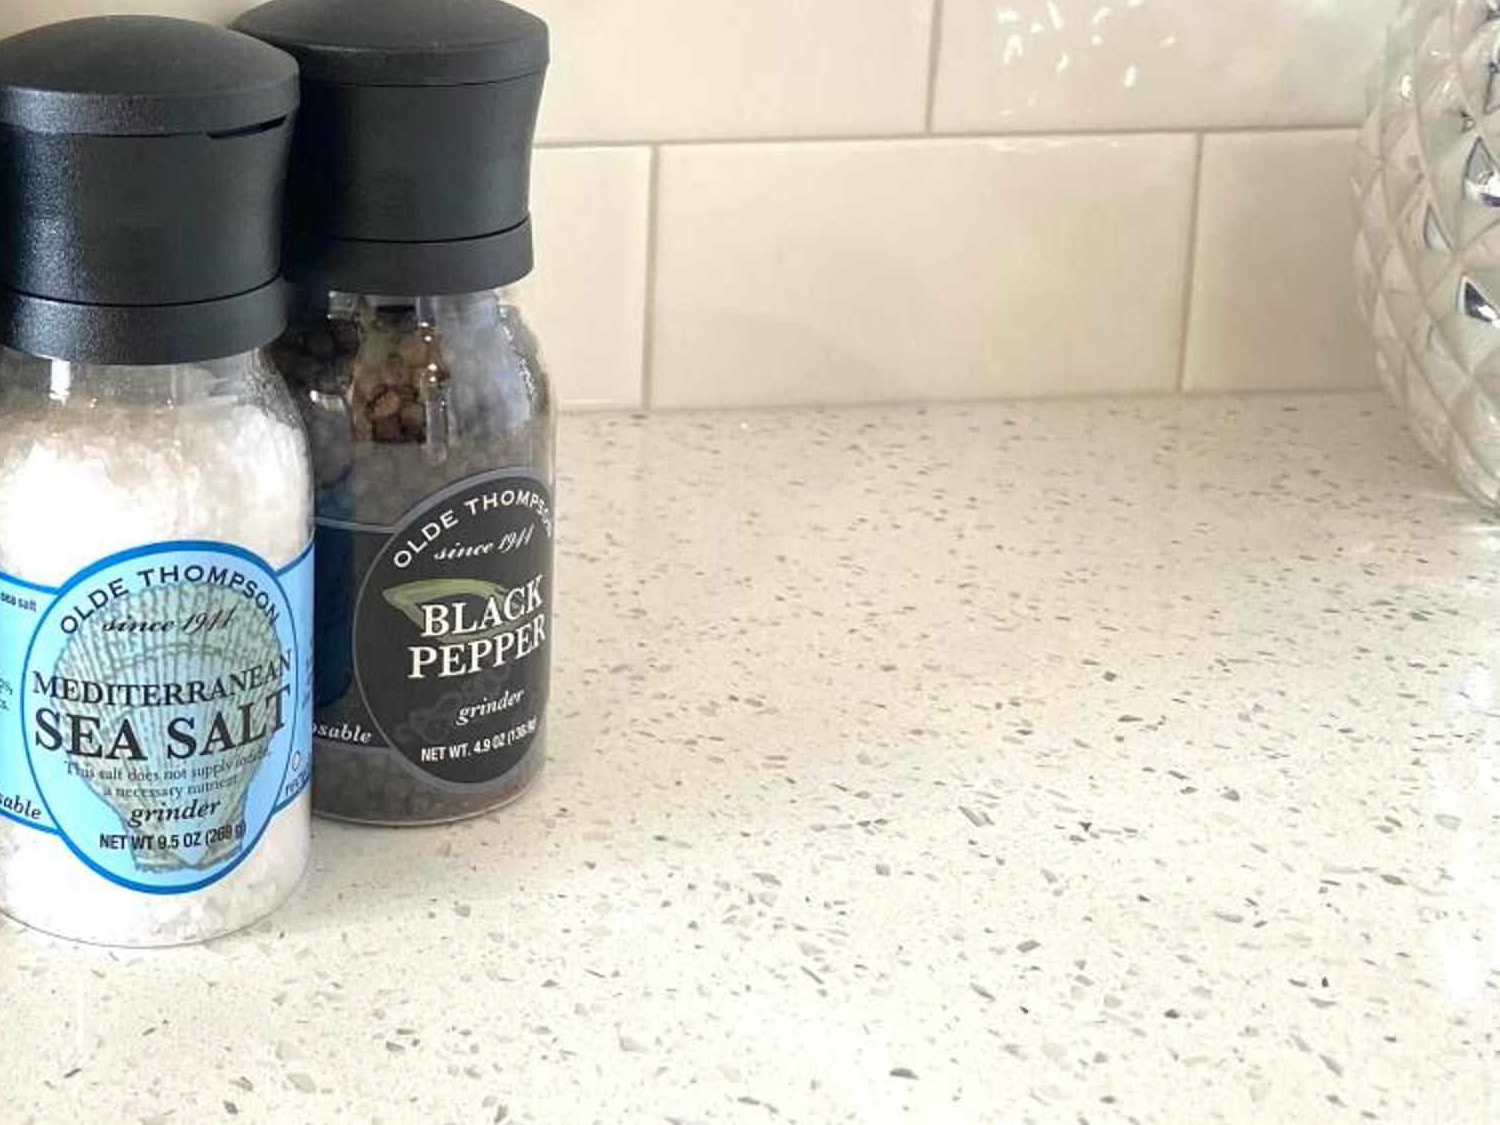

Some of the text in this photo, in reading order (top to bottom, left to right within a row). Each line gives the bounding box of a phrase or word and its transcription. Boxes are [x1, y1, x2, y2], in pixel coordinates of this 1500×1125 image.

[393, 509, 459, 568] OLDE
[434, 542, 495, 561] since
[18, 596, 37, 612] salt
[61, 578, 129, 635] OLDE
[137, 564, 280, 626] THOMPSON
[421, 574, 544, 638] BLACK
[102, 613, 175, 633] since
[407, 613, 547, 681] PEPPER
[32, 648, 292, 707] MEDITERRANEAN
[455, 689, 525, 726] grinder
[35, 685, 292, 762] SEA SALT
[421, 746, 446, 762] NET
[449, 742, 471, 759] WT.
[473, 739, 491, 753] 4.9
[64, 760, 95, 779] This
[99, 766, 123, 781] salt
[127, 766, 159, 782] does
[163, 766, 188, 781] not
[191, 757, 232, 781] supply
[116, 783, 183, 801] necessary
[128, 798, 221, 829] grinder
[100, 833, 126, 850] NET
[131, 833, 155, 850] WT
[158, 833, 179, 851] 9.5
[183, 831, 201, 848] OZ
